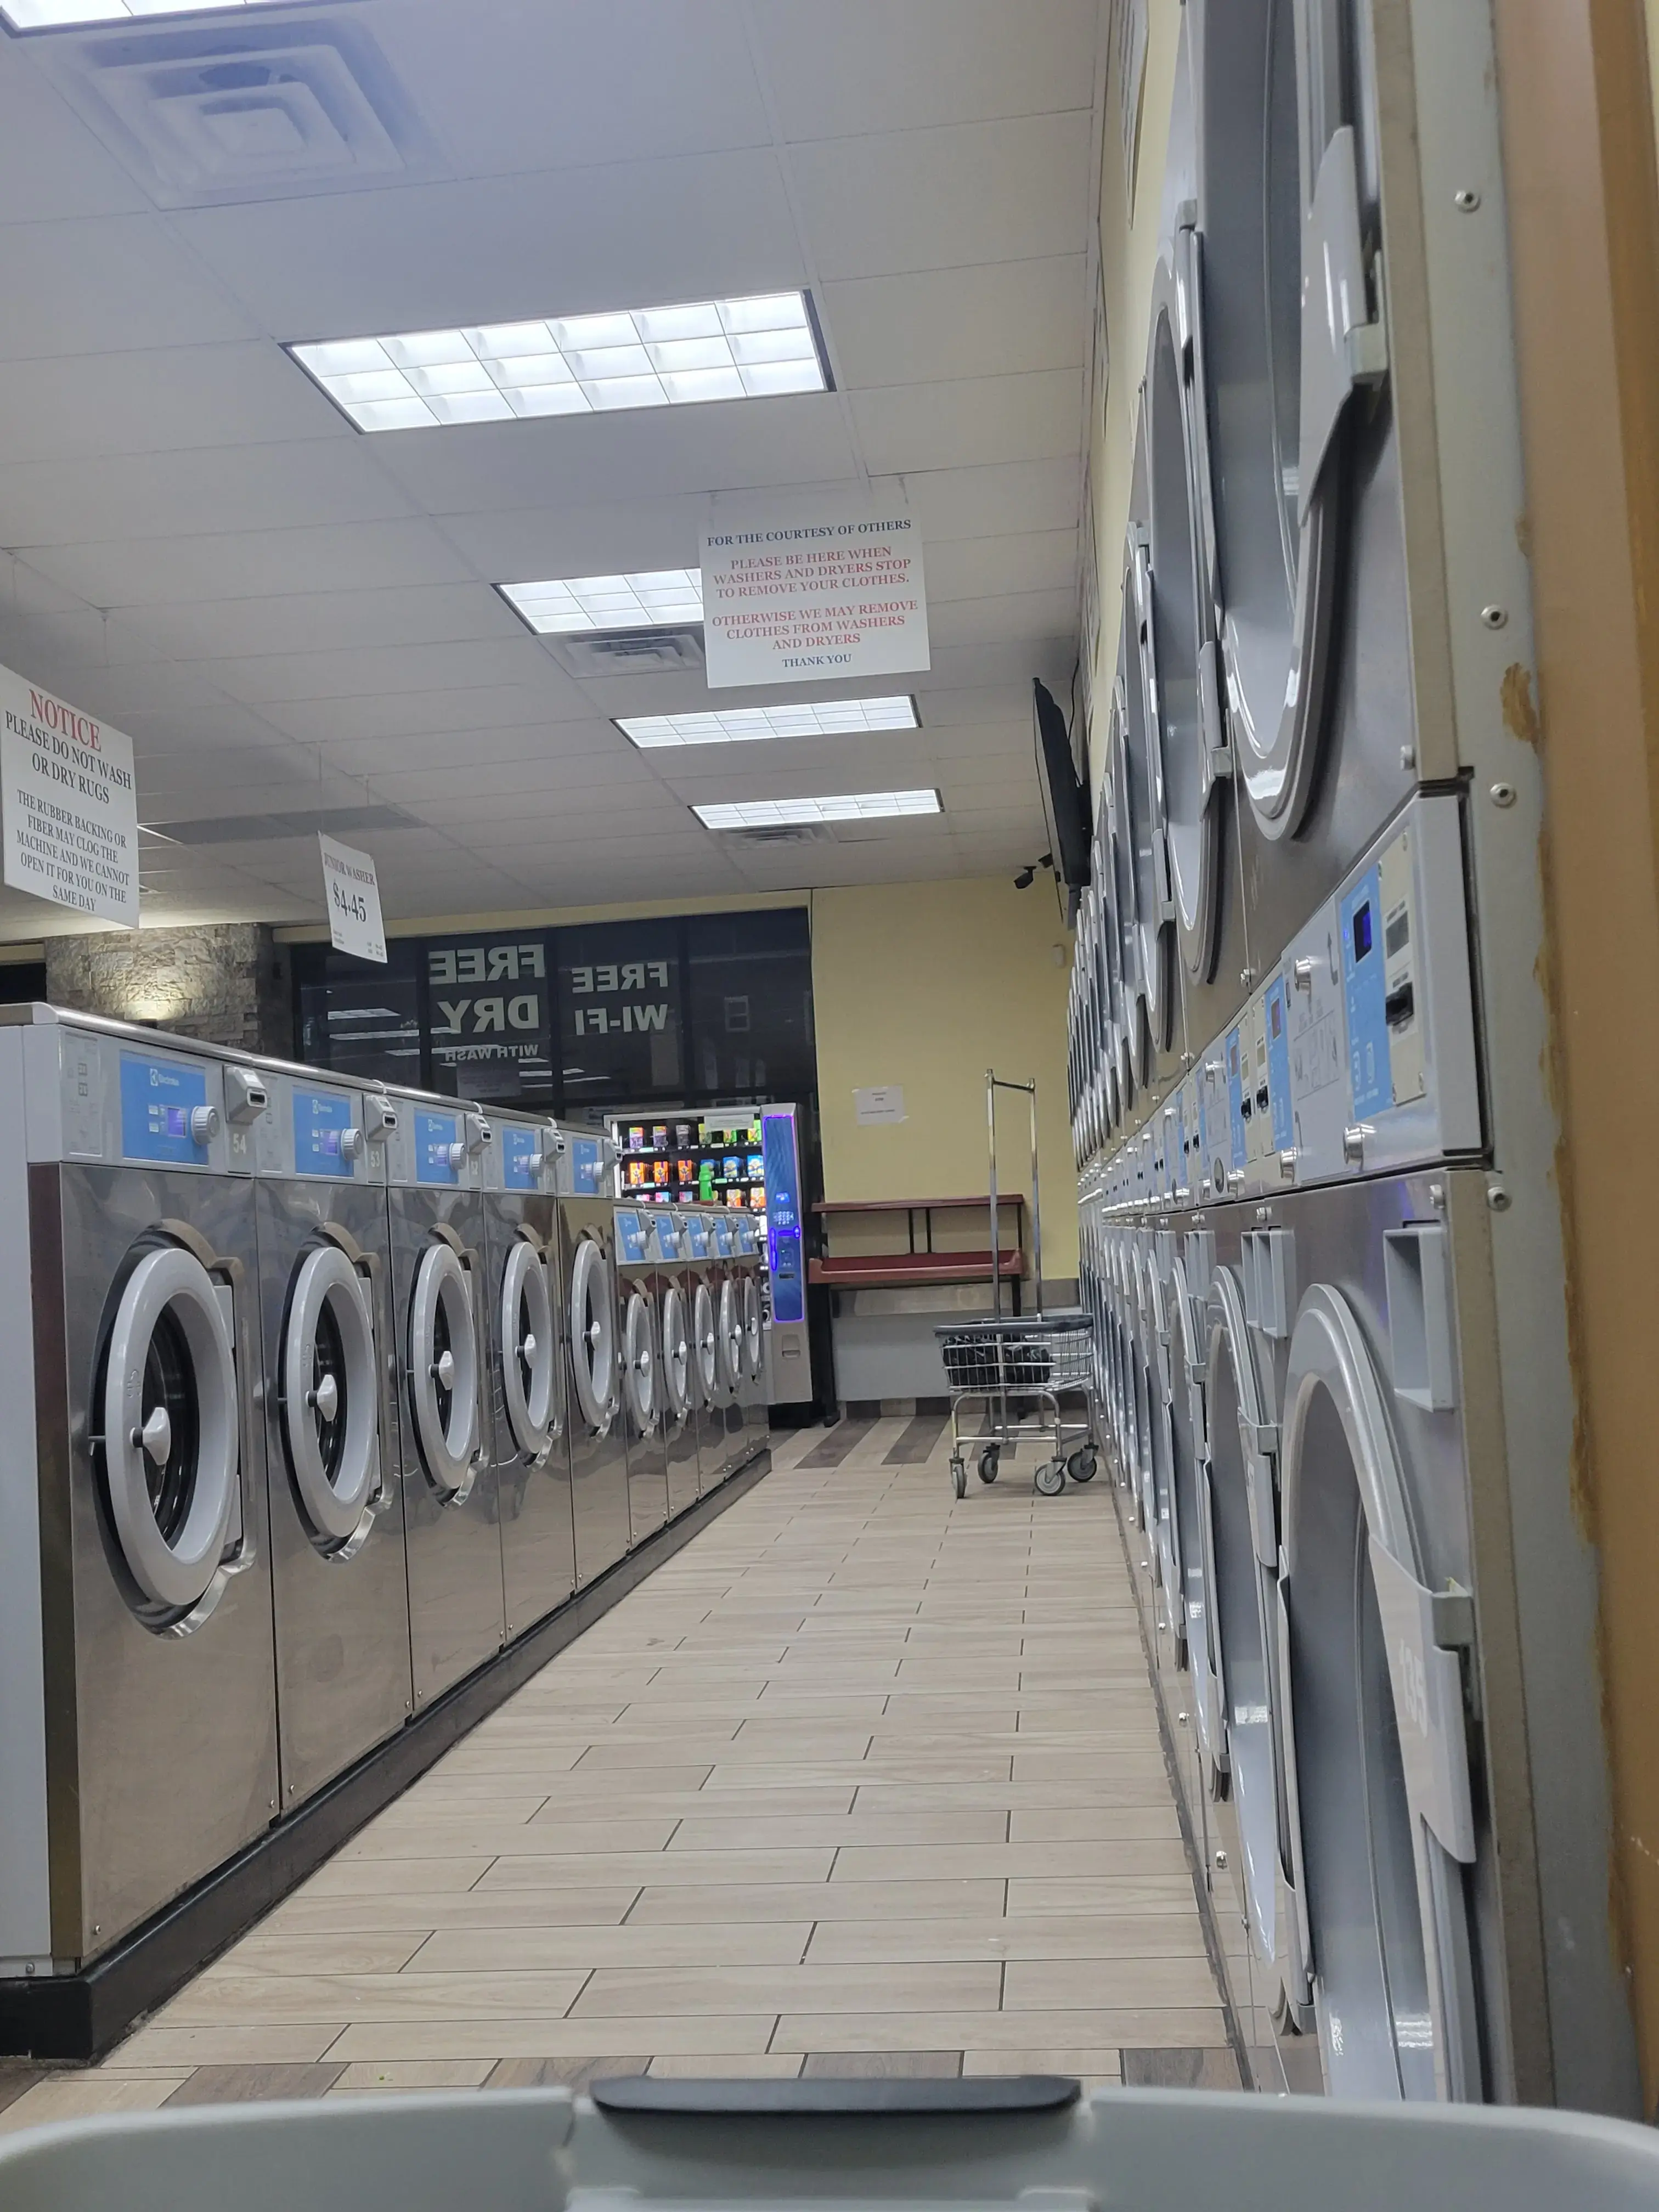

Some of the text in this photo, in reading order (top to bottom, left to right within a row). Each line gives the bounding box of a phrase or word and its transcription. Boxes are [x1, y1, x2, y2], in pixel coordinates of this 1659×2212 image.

[707, 520, 911, 546] FOR THE COURTESY OF OTHERS
[731, 546, 891, 569] PLEASE BE HERE WHEN
[713, 559, 911, 584] WASHERS AND DRYERS STOP
[716, 573, 909, 598] TO REMOVE YOUR CLOTHES.
[713, 600, 918, 627] OTHERWISE WE MAY REMOVE
[727, 616, 905, 639] CLOTHES FROM WASHERS
[772, 633, 860, 649] AND DRYERS
[782, 654, 852, 667] THANK YOU
[29, 689, 101, 752] NOTICE
[5, 710, 132, 789] PLEASE DO NOT WASH
[32, 753, 109, 804] OR DRY RUGS
[18, 789, 126, 848] THE RUBBER BACKING OR
[28, 814, 118, 863] FIBER MAY CLOG THE
[17, 830, 129, 885] MACHINE AND WE CANNOT
[21, 852, 126, 903] OPEN IT FOR YOU ON THE
[346, 865, 375, 885] WASHER
[53, 885, 96, 911] SAME DAY
[333, 879, 366, 922] $4.45
[233, 1133, 246, 1153] 54
[370, 1152, 380, 1168] 53
